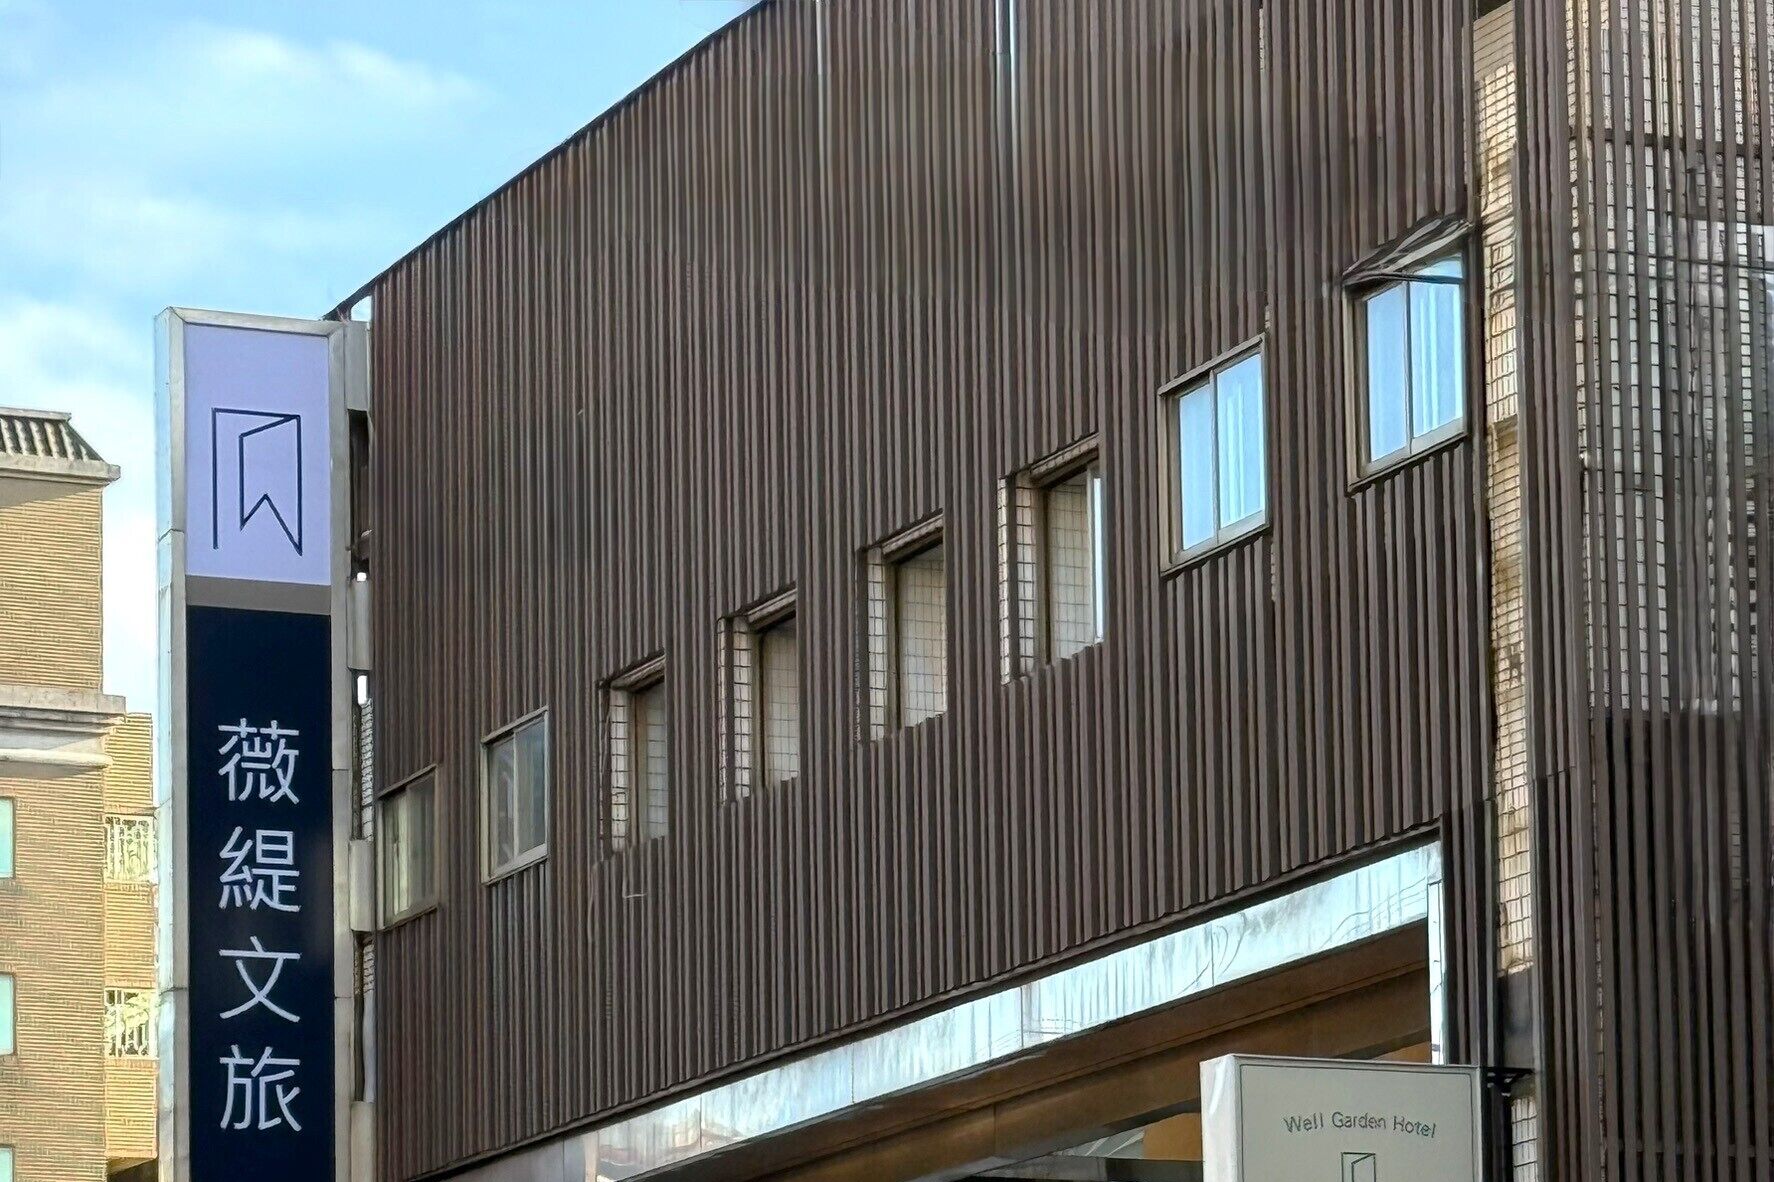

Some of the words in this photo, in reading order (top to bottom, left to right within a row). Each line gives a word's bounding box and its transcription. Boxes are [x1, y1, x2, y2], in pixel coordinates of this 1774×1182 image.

[217, 717, 302, 1132] 薇緹文旅
[1283, 1112, 1324, 1133] Well
[1331, 1111, 1386, 1130] Garden
[1392, 1115, 1436, 1138] Hotel
